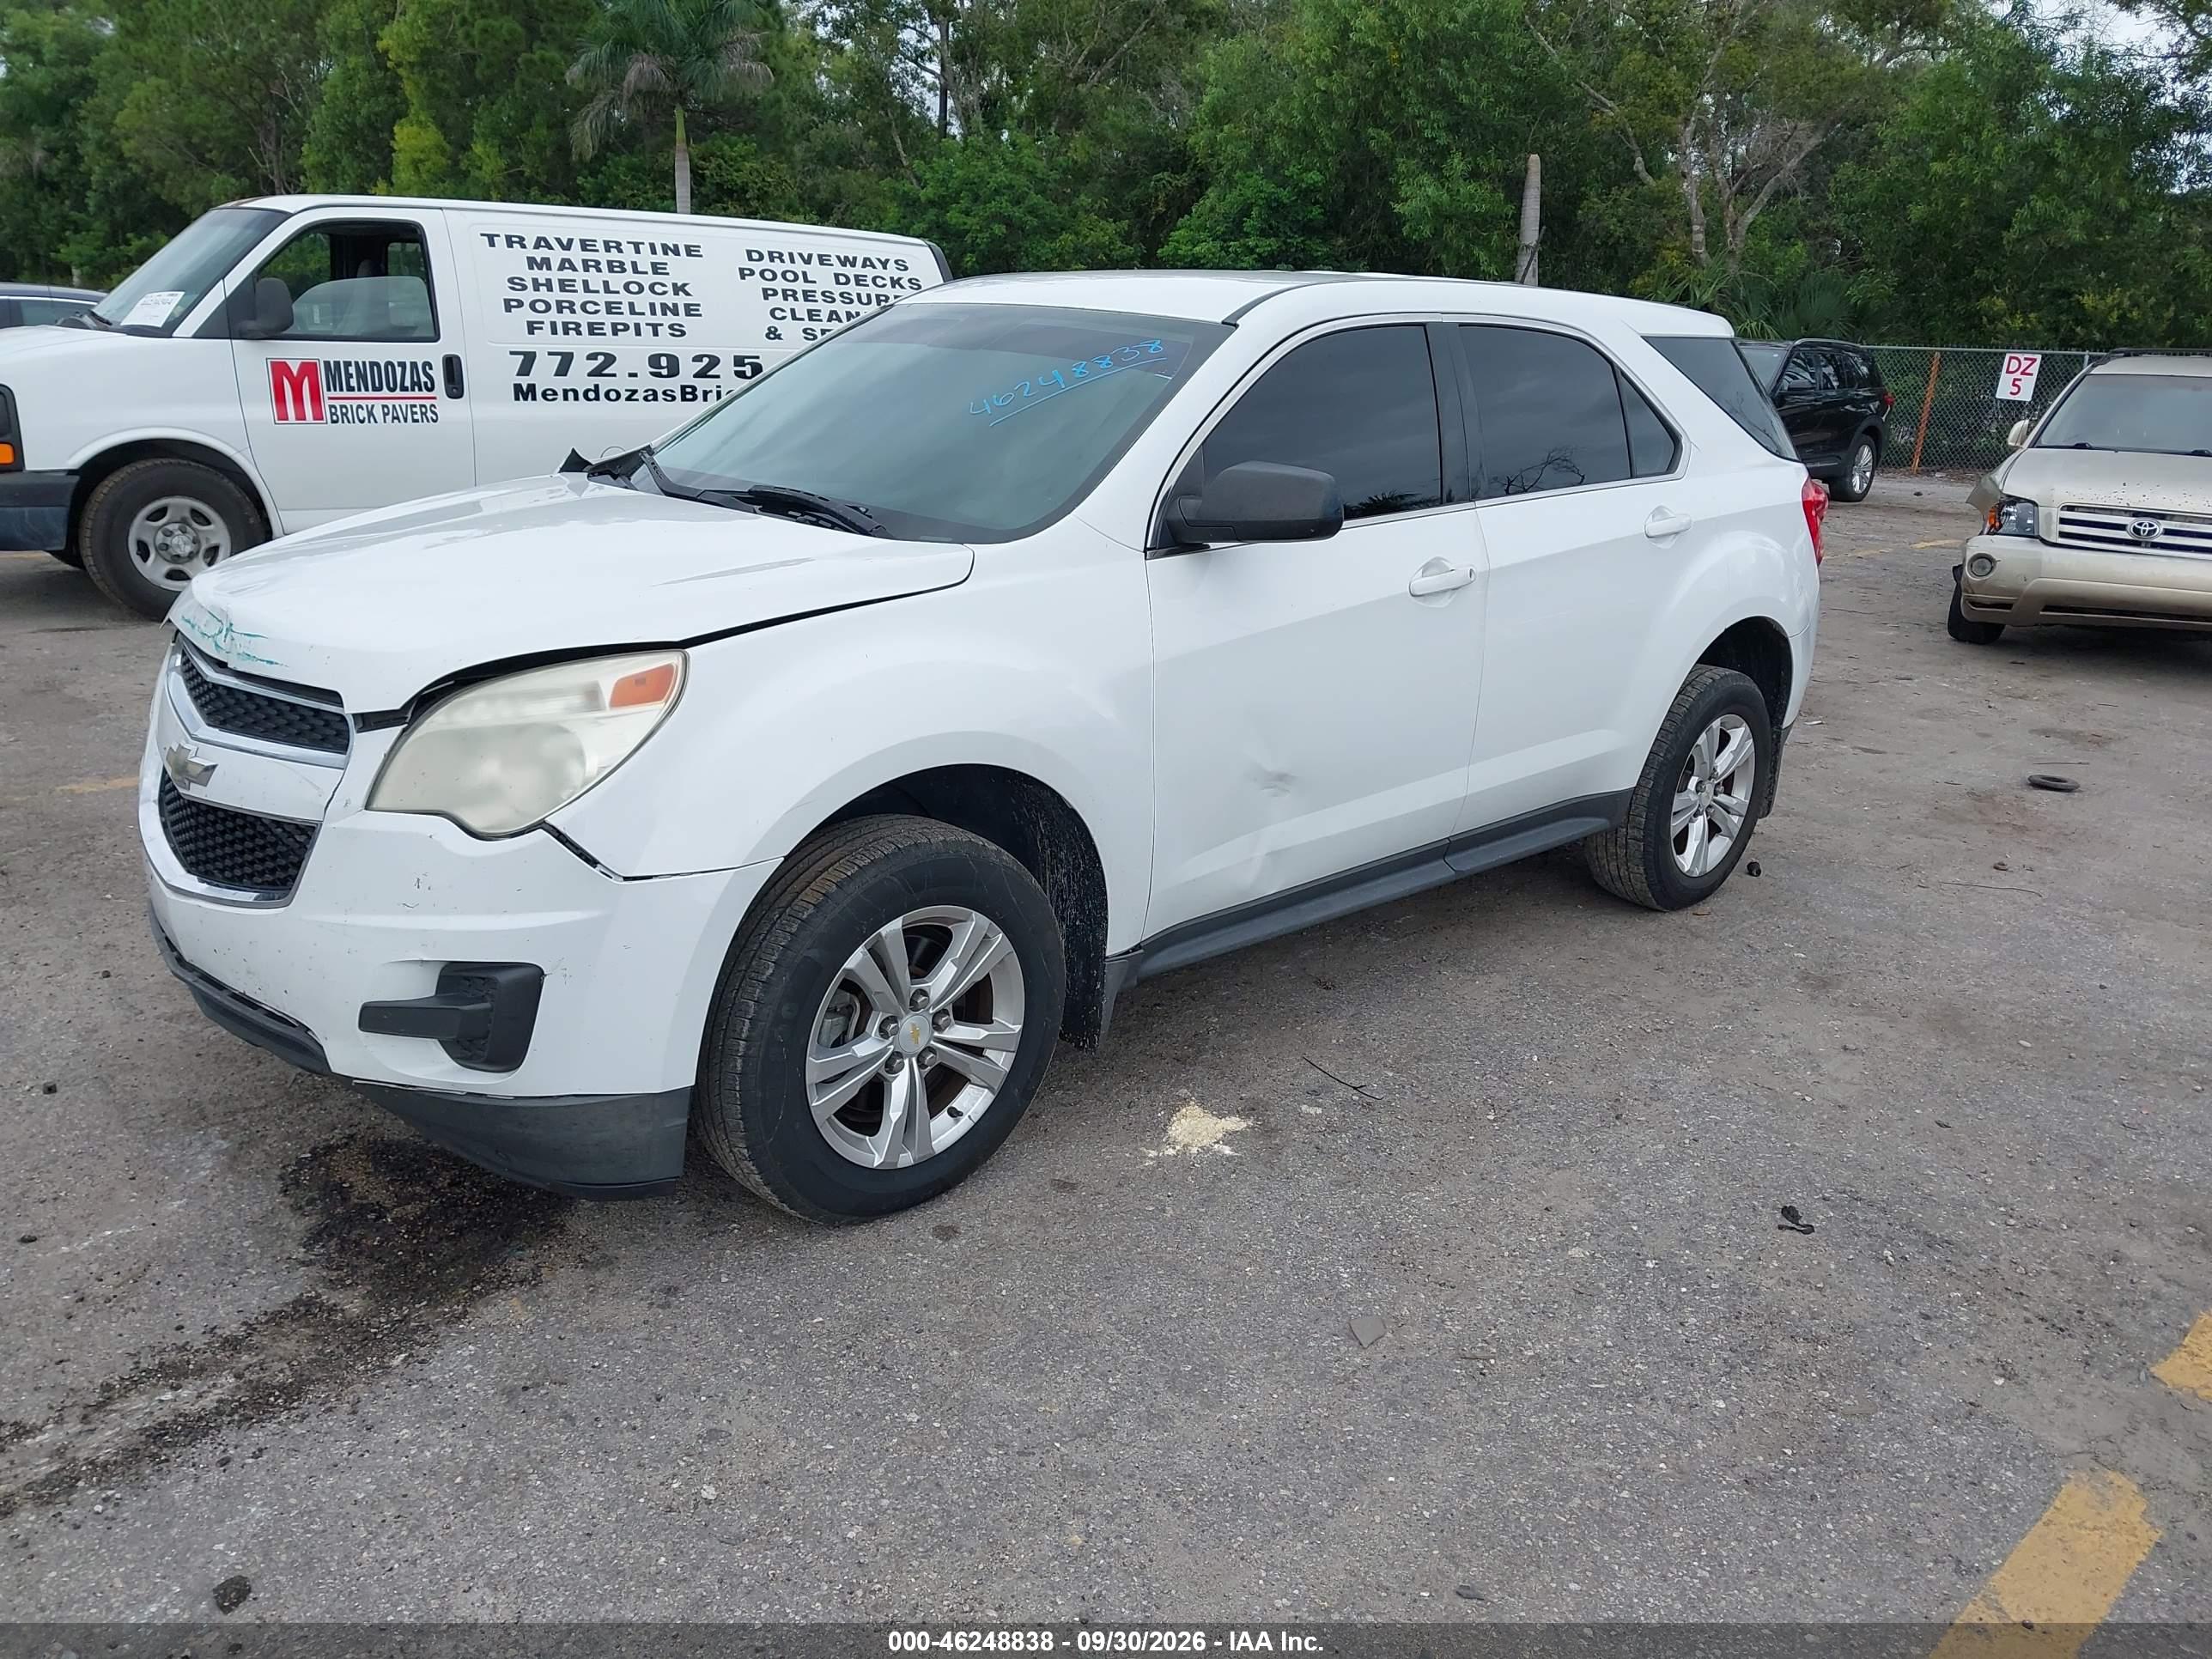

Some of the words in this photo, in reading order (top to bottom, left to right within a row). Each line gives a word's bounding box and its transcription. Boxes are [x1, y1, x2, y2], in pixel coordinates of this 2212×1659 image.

[480, 233, 703, 258] TRAVERTINE
[526, 256, 669, 276] MARBLE
[745, 249, 909, 271] DRIVEWAYS
[507, 276, 692, 297] SHELLOCK
[738, 267, 817, 284] POOL
[833, 272, 922, 290] DECKS
[504, 298, 702, 318] PORCELINE
[769, 307, 867, 323] CLEAN
[526, 320, 687, 338] FIREPITS
[765, 325, 783, 341] &
[509, 350, 763, 380] 772.925
[2005, 356, 2038, 376] DZ
[325, 361, 435, 392] MENDOZAS
[969, 340, 1164, 414] 46248838
[270, 361, 325, 421] M
[2009, 378, 2022, 396] 5
[329, 404, 378, 424] BRICK
[383, 404, 439, 424] PAVERS
